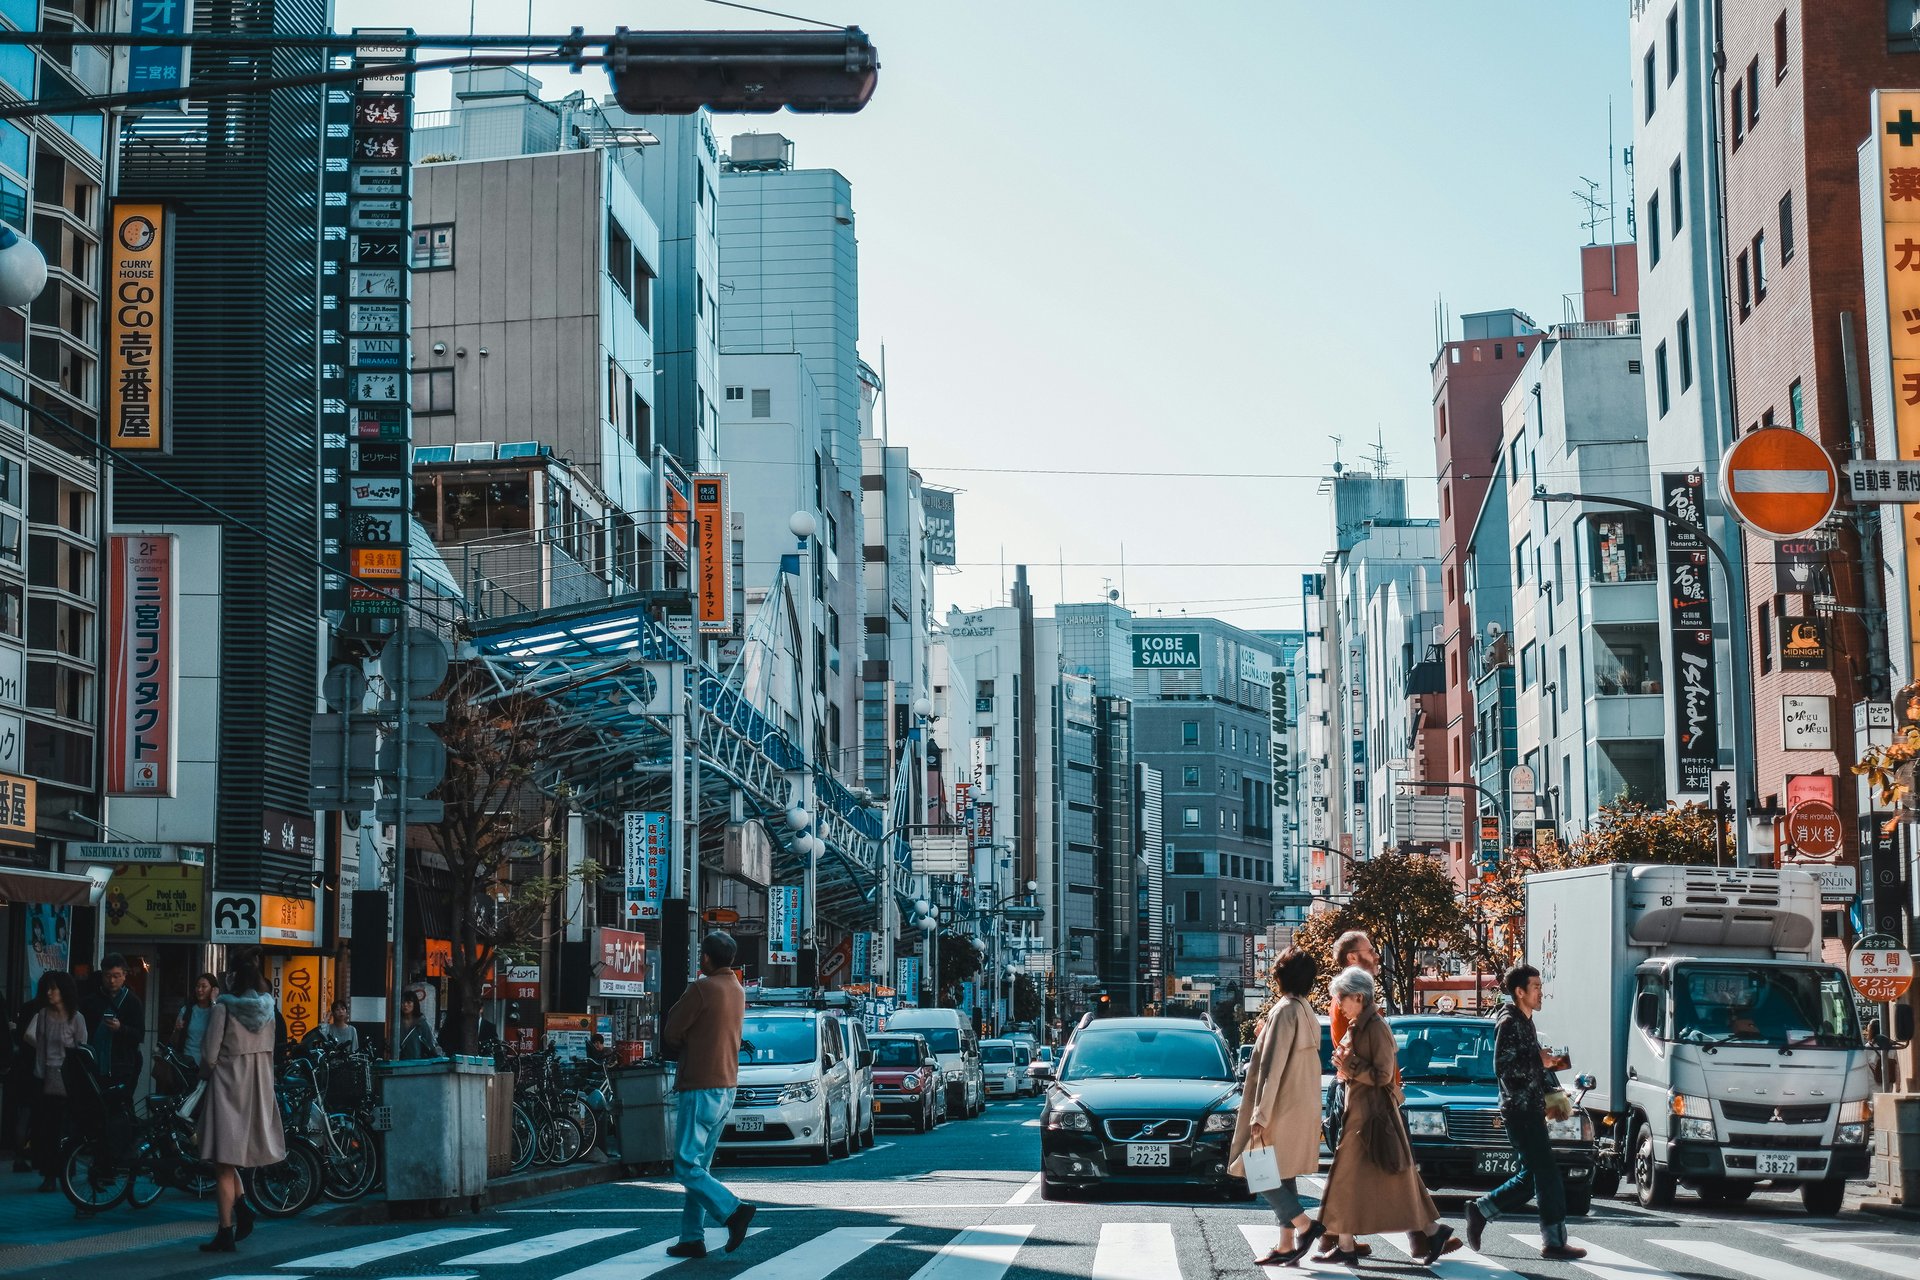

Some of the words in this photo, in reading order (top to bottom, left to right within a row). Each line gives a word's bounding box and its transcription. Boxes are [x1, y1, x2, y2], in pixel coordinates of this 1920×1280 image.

[134, 65, 177, 79] 三宮校
[360, 242, 399, 256] ランス
[120, 260, 153, 269] CURRY
[119, 270, 154, 279] HOUSE
[364, 341, 393, 352] WIN
[361, 453, 398, 462] ビリヤード
[1687, 474, 1700, 483] 8F
[140, 542, 158, 556] 2F
[1782, 544, 1816, 553] CLICK
[1692, 553, 1706, 562] 7F
[134, 565, 163, 573] Contact
[704, 515, 714, 618] コミック・インターネット
[1064, 615, 1105, 625] CHARMANT
[1093, 628, 1104, 638] 13
[1697, 632, 1711, 641] 3F
[1141, 637, 1183, 650] KOBE
[1241, 650, 1255, 665] KOBE
[1783, 648, 1825, 656] MIDNIGHT
[1142, 652, 1197, 665] SAUNA
[1800, 660, 1810, 668] 5F
[134, 577, 161, 760] 三宮コンタクト
[1271, 671, 1288, 735] HANDS
[1681, 652, 1711, 750] Ishida
[1789, 699, 1804, 707] Bar
[1787, 710, 1818, 723] Megu
[1873, 715, 1888, 723] ビル
[1797, 722, 1828, 735] Megu
[1274, 743, 1289, 808] TOKYU
[1796, 824, 1836, 842] 消火栓
[80, 846, 130, 858] NISHIMURA'S
[133, 847, 162, 859] COFFEE
[635, 815, 645, 886] テナントホーム
[156, 889, 171, 899] Pool
[172, 890, 187, 899] club
[146, 899, 173, 912] Break
[175, 900, 197, 912] Nine
[1660, 895, 1673, 906] 18
[215, 897, 257, 929] 63
[173, 923, 196, 933] 3F
[235, 929, 256, 937] BISTRO
[1857, 977, 1907, 988] タクシー
[518, 987, 535, 998] 賃貸
[1867, 987, 1897, 997] のりば
[740, 1121, 763, 1132] 73-37
[1136, 1153, 1167, 1165] 22-25
[1484, 1160, 1517, 1172] 87-46
[1765, 1161, 1795, 1174] 38-22
